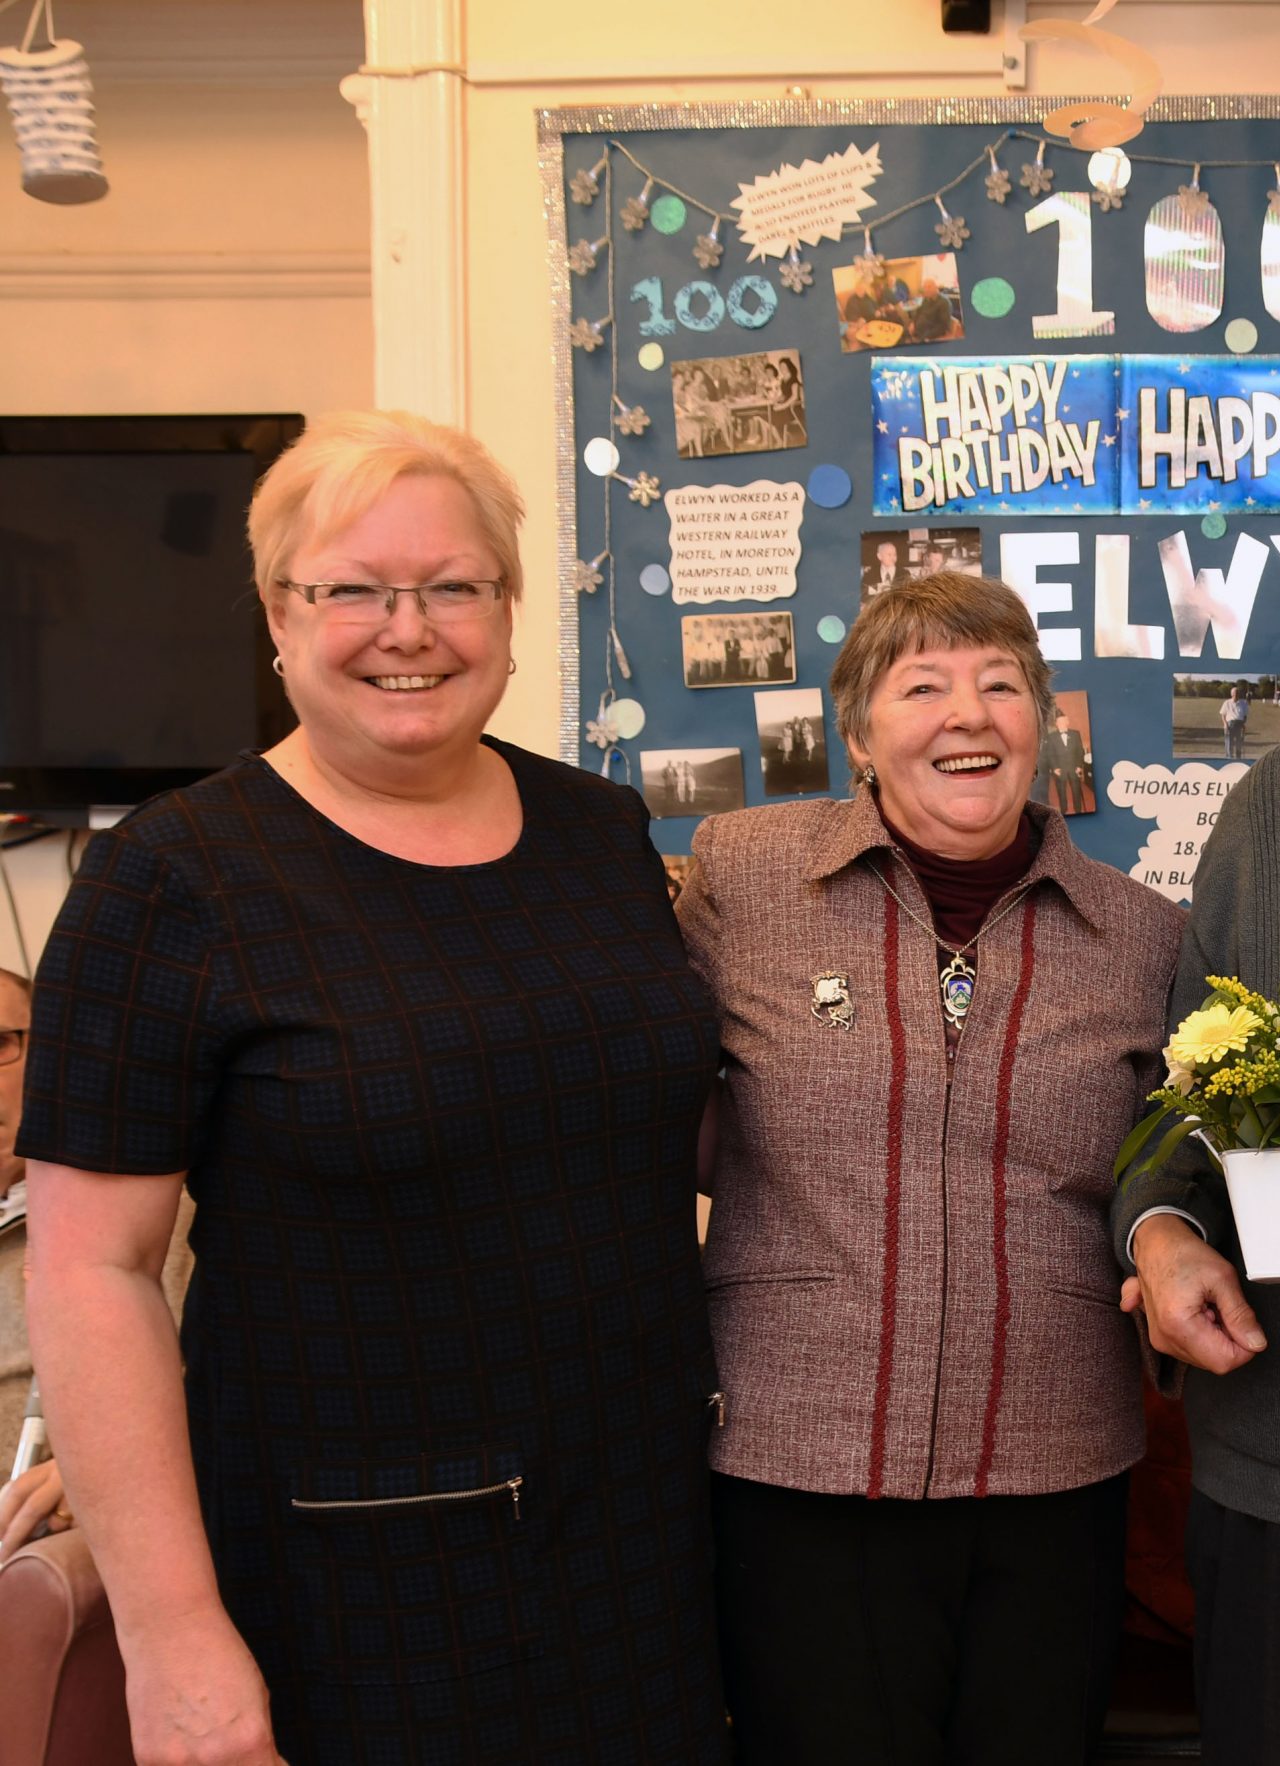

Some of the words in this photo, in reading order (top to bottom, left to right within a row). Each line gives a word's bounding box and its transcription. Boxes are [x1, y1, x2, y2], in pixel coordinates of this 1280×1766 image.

[780, 183, 801, 193] WON
[804, 175, 825, 186] LOTS
[841, 165, 863, 176] CUPS
[751, 202, 786, 216] MEDALS
[779, 208, 816, 222] ENJOYED
[819, 196, 856, 210] PLAYING
[629, 274, 779, 336] 100
[918, 359, 1070, 445] HAPPY
[897, 419, 1101, 513] BIRTHDAY
[675, 494, 715, 505] ELWYN
[719, 492, 770, 504] WORKED
[773, 492, 788, 502] AS
[791, 492, 800, 501] A
[676, 512, 720, 523] WAITER
[724, 512, 736, 521] IN
[740, 512, 748, 520] A
[751, 510, 789, 521] GREAT
[676, 531, 732, 541] WESTERN
[735, 529, 788, 540] RAILWAY
[676, 549, 715, 560] HOTEL,
[720, 549, 732, 559] IN
[735, 548, 796, 559] MORETON
[677, 567, 752, 578] HAMPSTEAD,
[756, 566, 789, 576] UNTIL
[678, 586, 698, 596] THE
[703, 586, 730, 595] WAR
[734, 586, 746, 594] IN
[1124, 780, 1200, 796] THOMAS
[1144, 871, 1163, 884] IN
